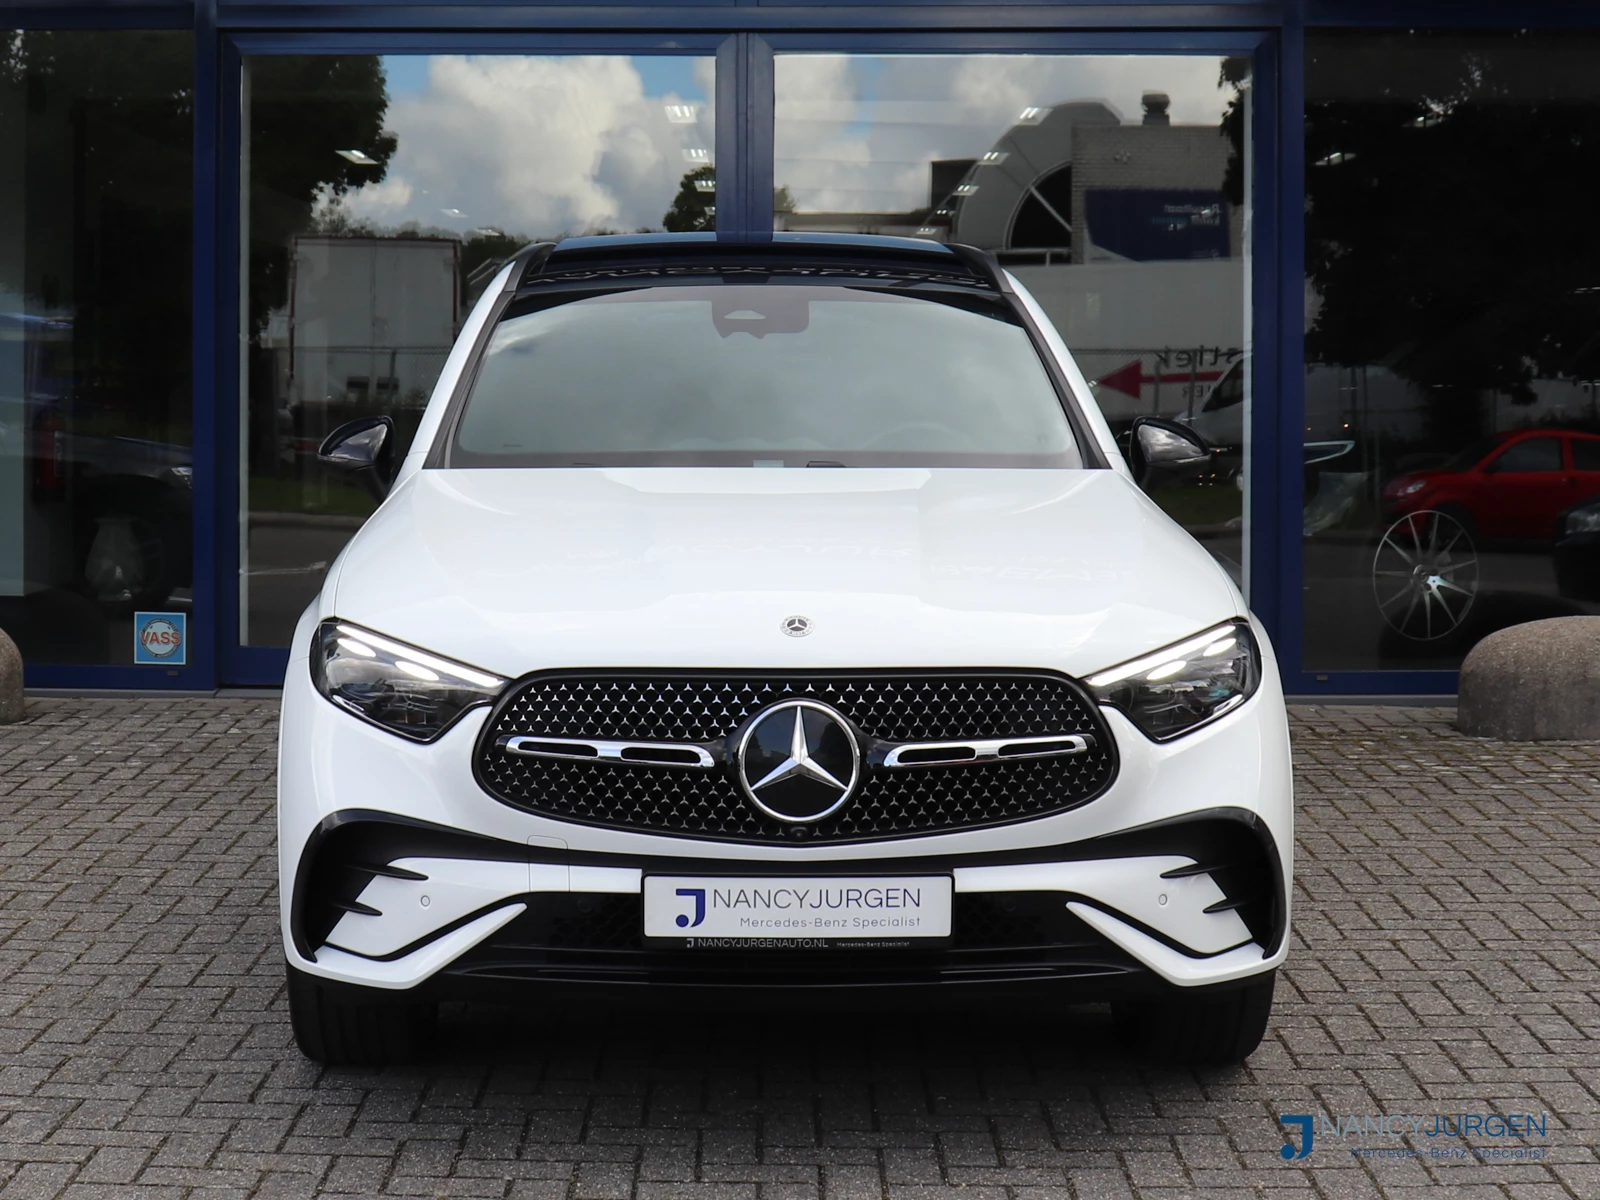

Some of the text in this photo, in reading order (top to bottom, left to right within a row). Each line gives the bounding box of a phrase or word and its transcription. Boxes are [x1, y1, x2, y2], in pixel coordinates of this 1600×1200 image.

[140, 631, 181, 646] VASS
[713, 888, 921, 909] NANCYJURGEN
[740, 916, 921, 930] Mercedes-Benz Specialist
[697, 938, 829, 948] NANCYJURGENAUTO.NL
[881, 941, 910, 949] Specialist
